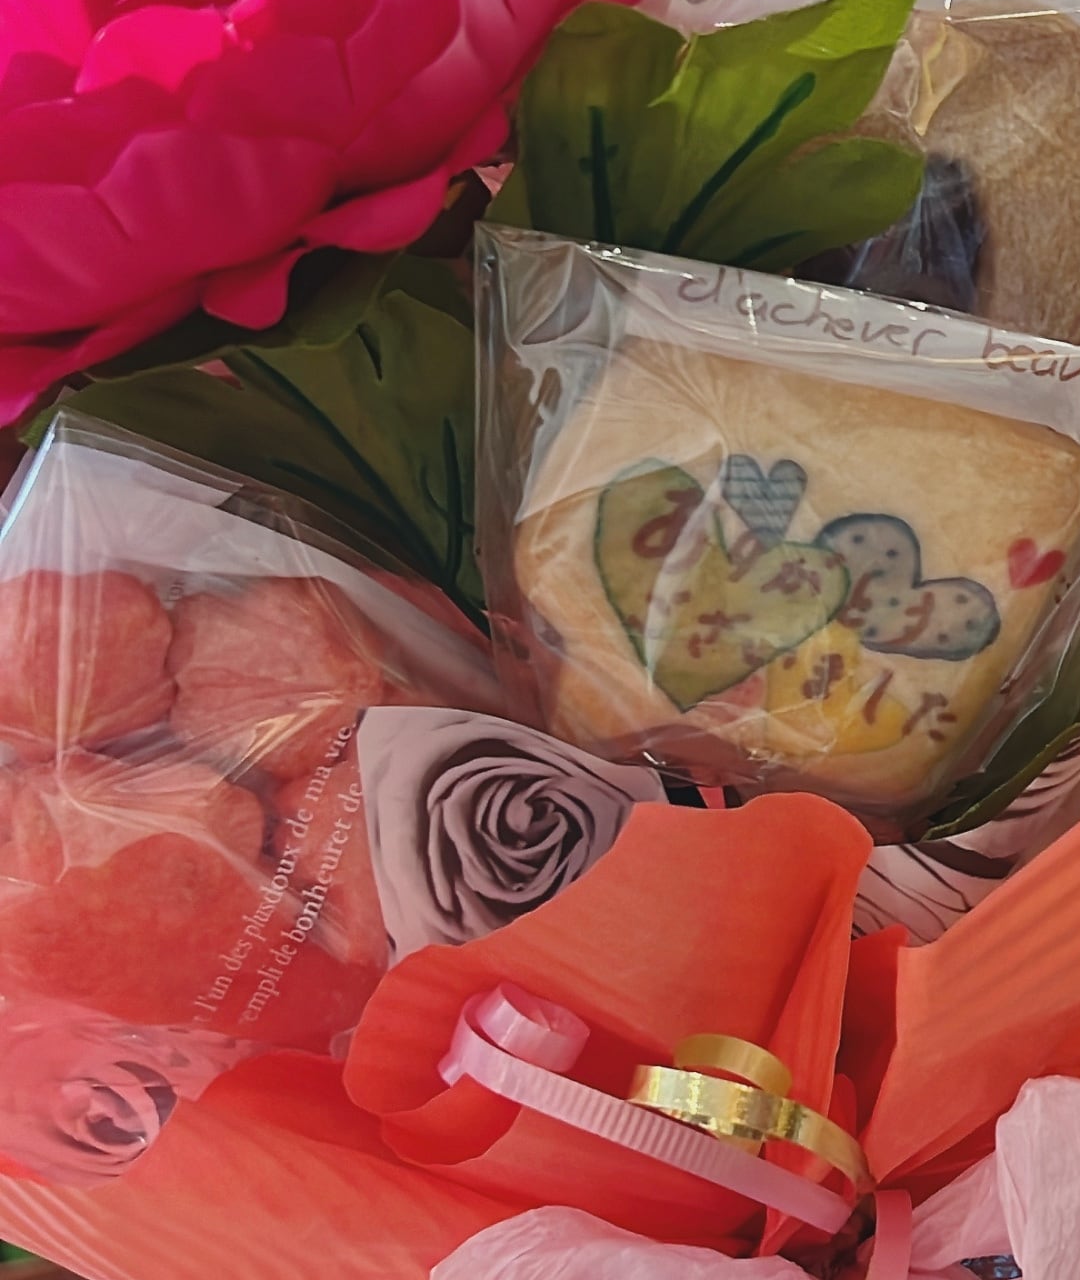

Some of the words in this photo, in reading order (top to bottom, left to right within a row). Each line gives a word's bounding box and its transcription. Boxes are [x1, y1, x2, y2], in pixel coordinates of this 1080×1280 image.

[677, 266, 948, 358] d'achever
[218, 938, 253, 972] des
[285, 806, 315, 841] de
[303, 765, 333, 802] ma
[238, 963, 285, 1025] empli
[268, 943, 298, 966] de
[337, 782, 363, 813] de
